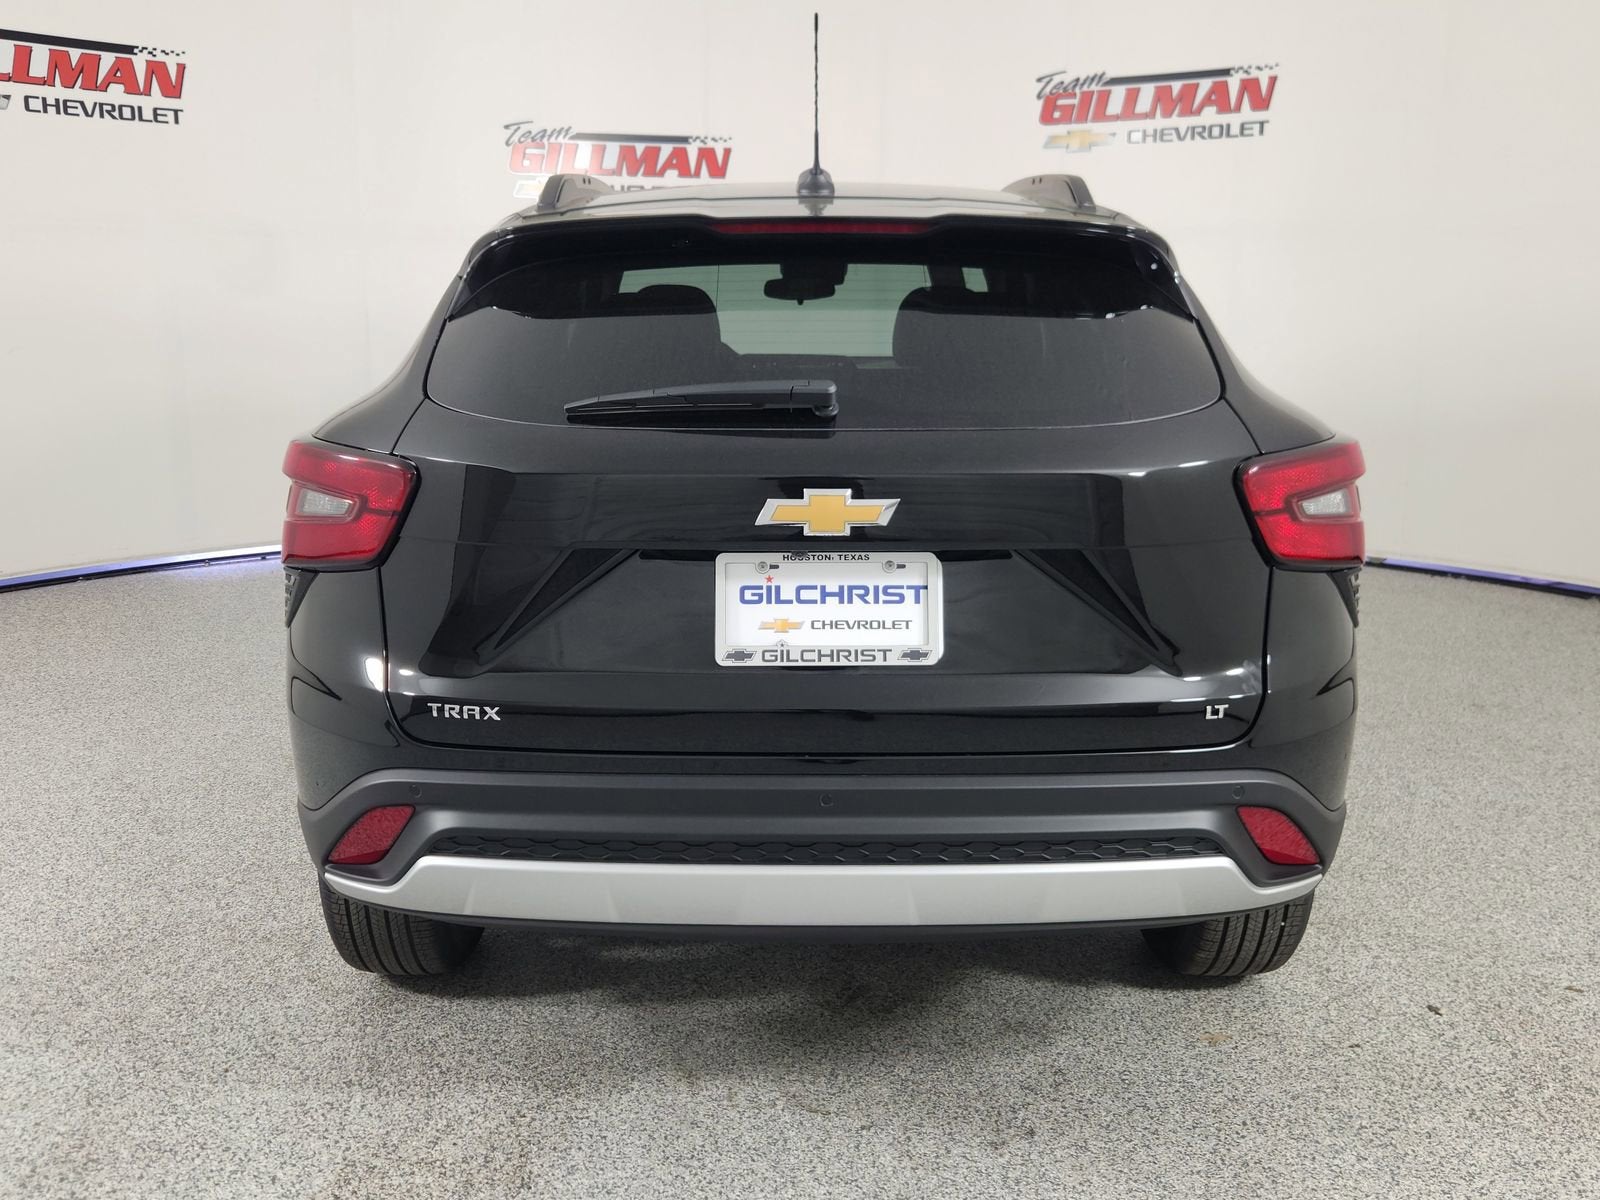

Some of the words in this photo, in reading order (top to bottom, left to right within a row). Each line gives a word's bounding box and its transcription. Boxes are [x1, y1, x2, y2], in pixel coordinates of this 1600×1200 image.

[1036, 70, 1109, 100] Team
[23, 94, 184, 125] CHEVROLET
[1038, 75, 1278, 126] GILLMAN
[503, 121, 573, 147] Team
[1126, 120, 1270, 145] CHEVROLET
[508, 142, 732, 179] GILLMAN
[739, 584, 928, 605] GILCHRIST
[810, 619, 913, 630] CHEVROLET
[761, 648, 893, 663] GILCHRIST
[427, 703, 501, 721] TRAX
[1205, 704, 1229, 720] LT
